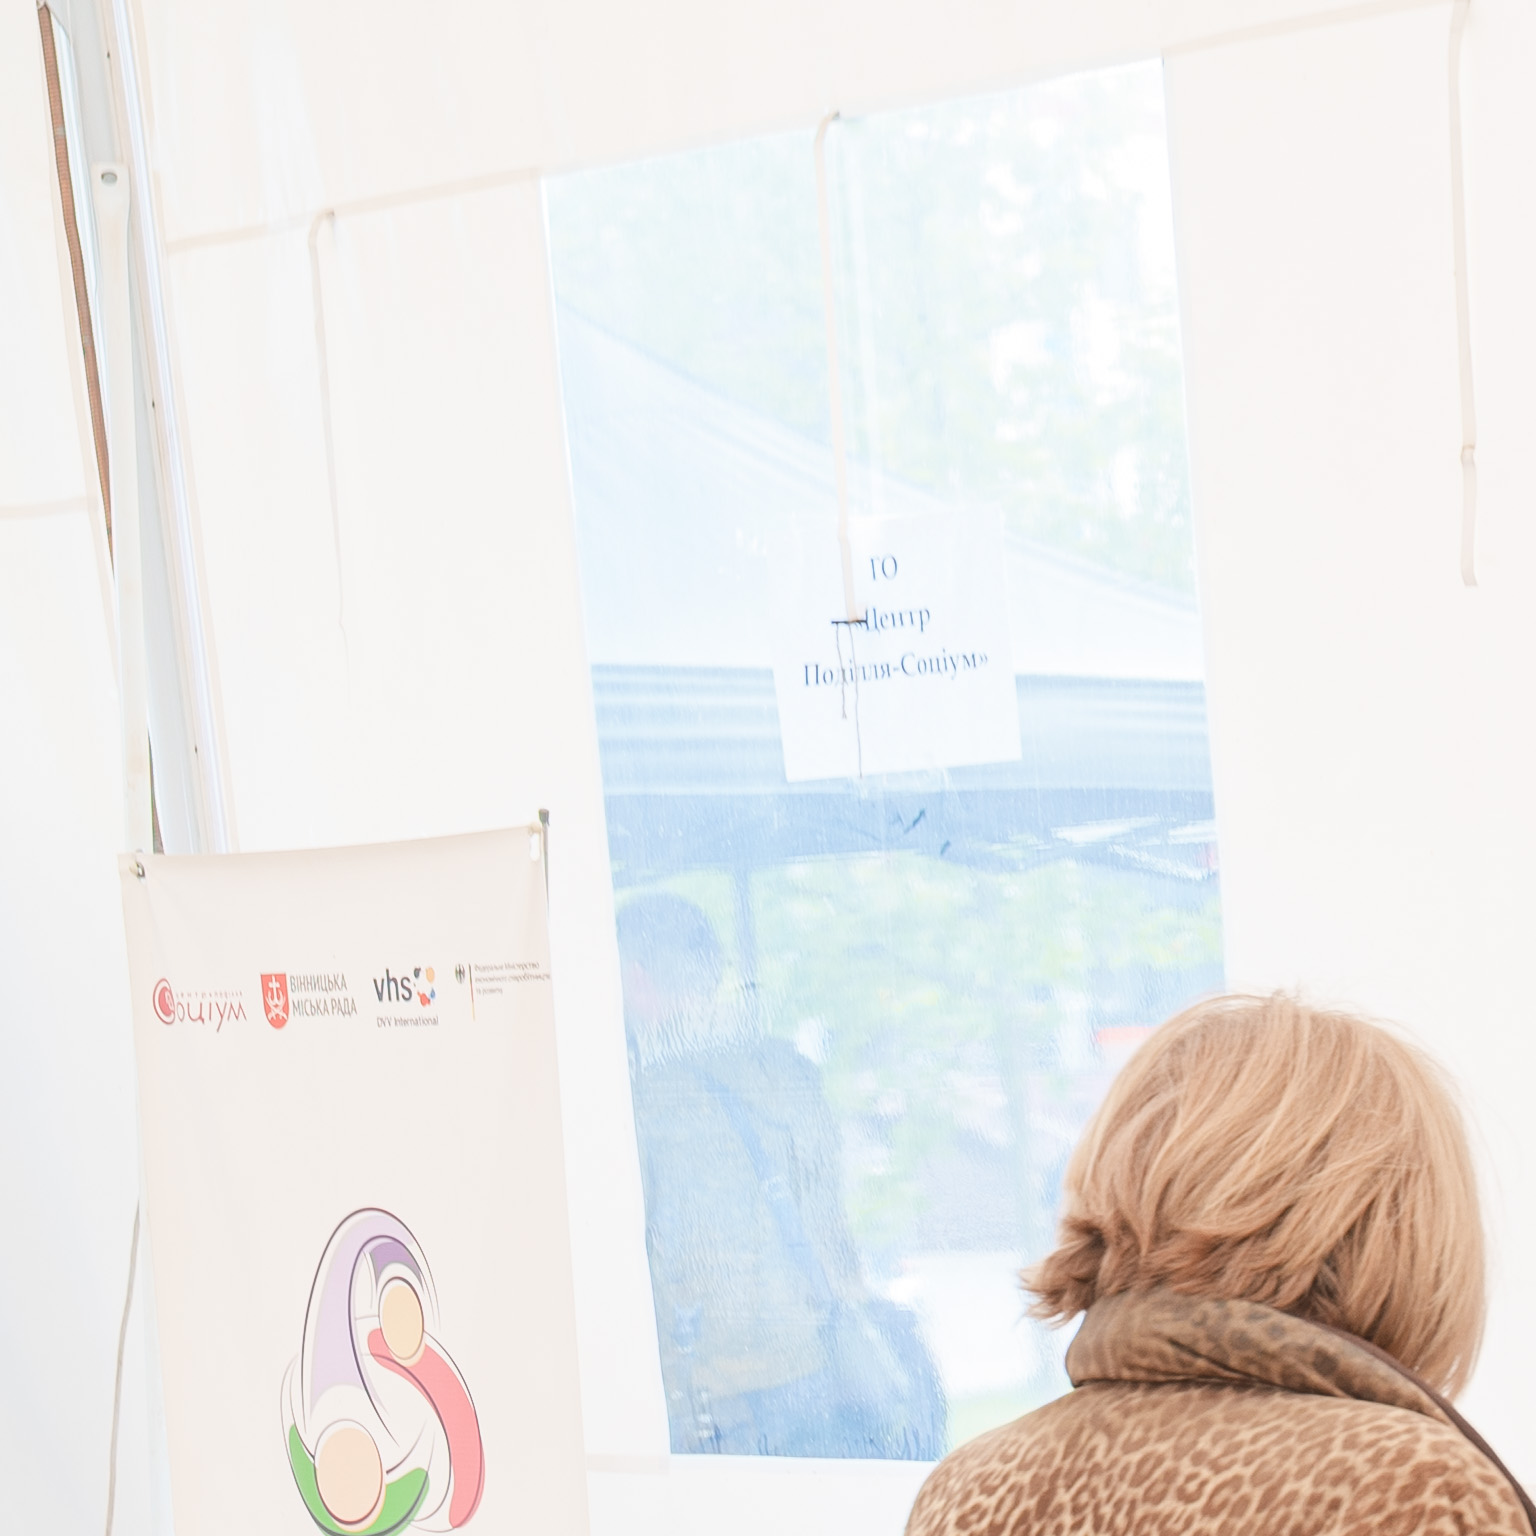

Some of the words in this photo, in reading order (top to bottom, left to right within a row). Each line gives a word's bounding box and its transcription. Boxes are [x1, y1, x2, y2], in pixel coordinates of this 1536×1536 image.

[870, 553, 898, 581] ГО
[290, 973, 347, 994] ВІННИЦЬКА
[373, 967, 412, 1002] vhs
[292, 998, 329, 1018] МІСЬКА
[332, 997, 358, 1018] РАДА
